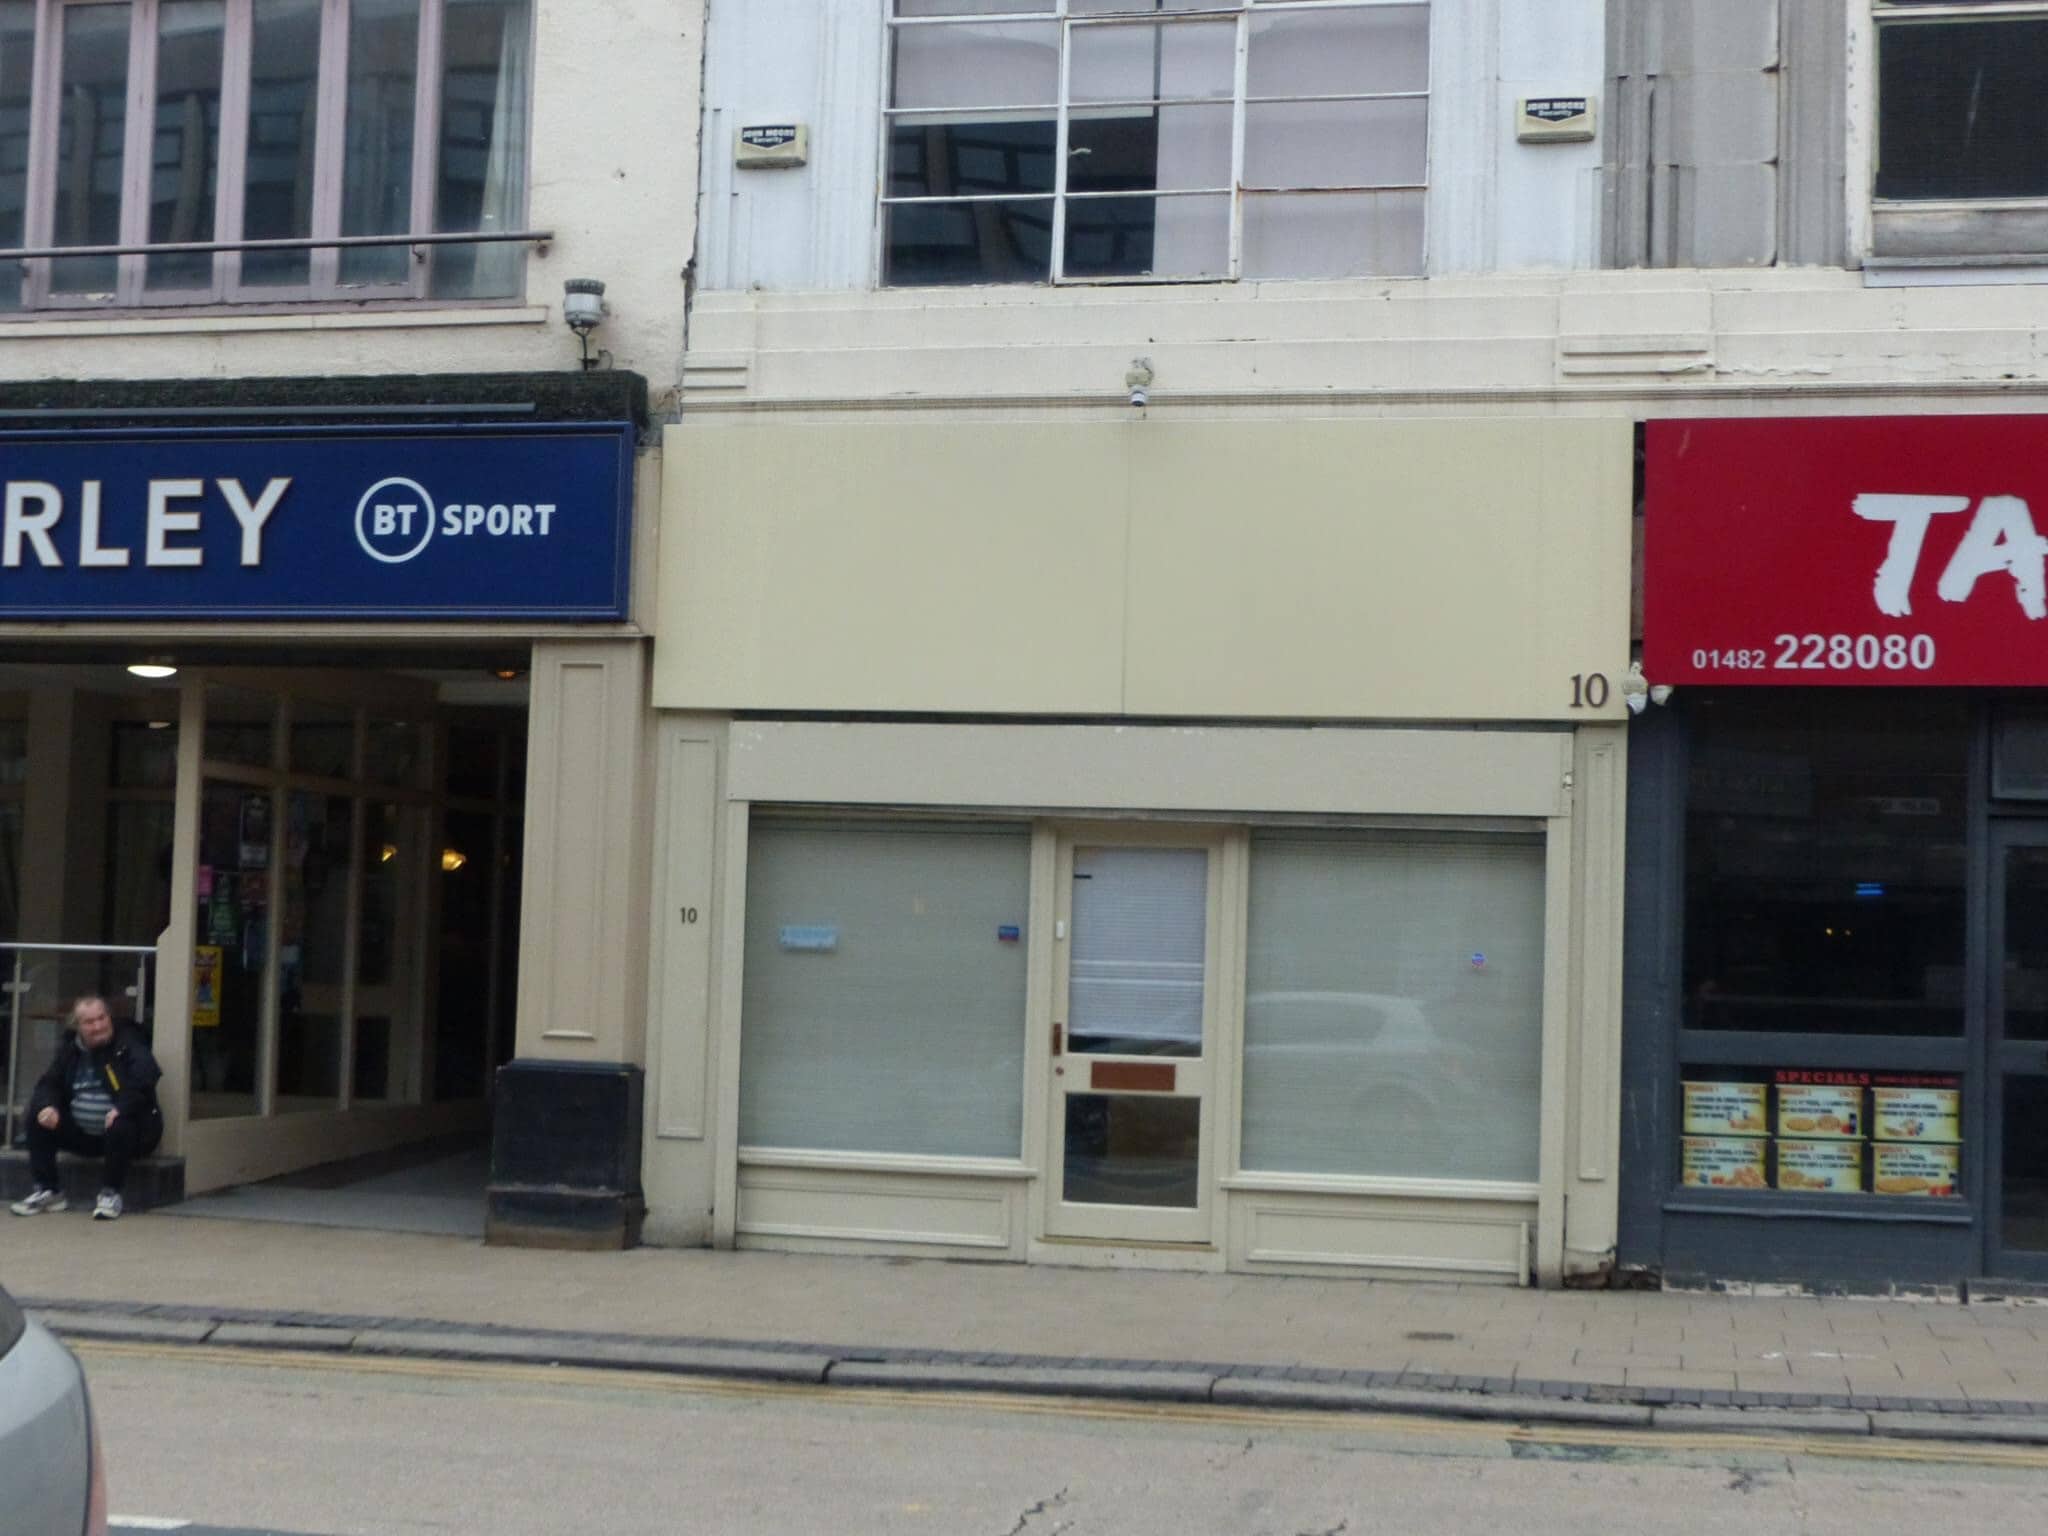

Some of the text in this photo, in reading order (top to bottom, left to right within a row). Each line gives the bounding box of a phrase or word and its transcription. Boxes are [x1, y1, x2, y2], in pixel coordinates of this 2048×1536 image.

[2, 478, 292, 567] RLEY
[373, 504, 556, 536] BT SPORT
[1692, 633, 1936, 670] 01482 228080
[1569, 673, 1610, 708] 10
[679, 906, 698, 924] 10
[1776, 1070, 1870, 1085] SPECIALS
